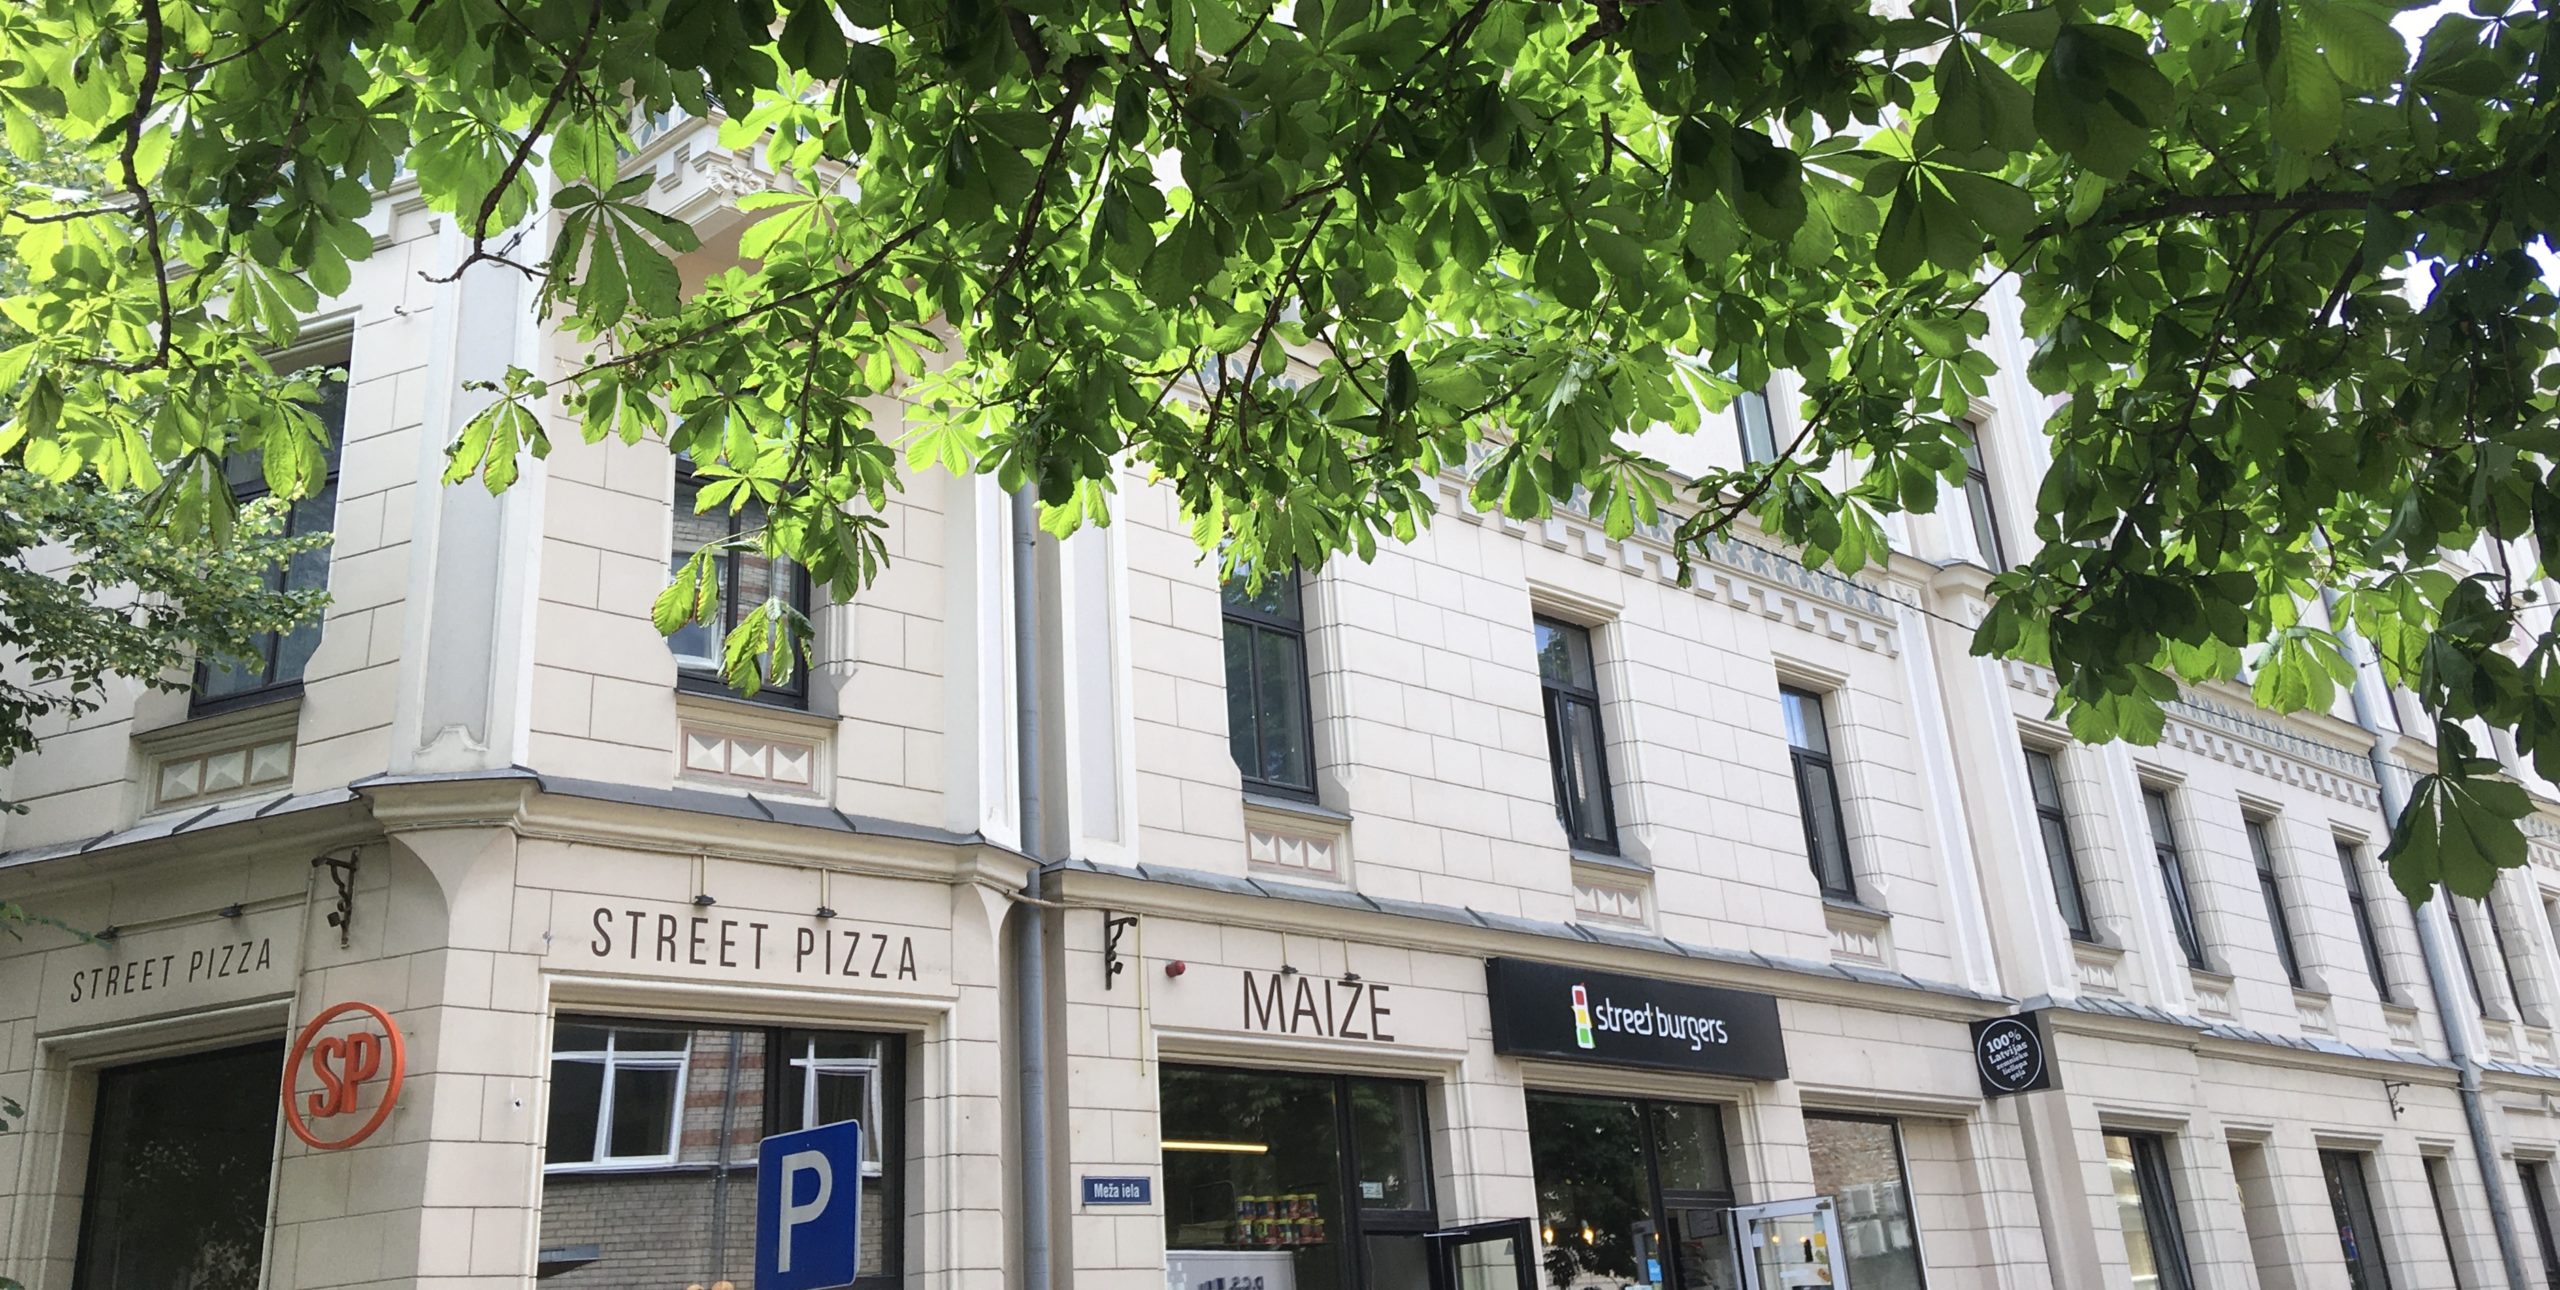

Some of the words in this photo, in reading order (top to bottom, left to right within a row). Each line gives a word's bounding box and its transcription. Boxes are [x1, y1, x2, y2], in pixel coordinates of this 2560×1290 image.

[70, 954, 175, 1003] STREET
[188, 937, 271, 984] PIZZA
[590, 907, 769, 970] STREET
[796, 926, 918, 981] PIZZA
[1243, 970, 1395, 1042] MAIZE
[1595, 997, 1653, 1036] street
[1655, 1005, 1729, 1051] burgers
[1986, 1028, 2022, 1053] 100%
[1988, 1041, 2028, 1065] Latvijas
[308, 1031, 382, 1118] SP
[777, 1149, 833, 1273] P
[1093, 1183, 1119, 1198] Meža
[1121, 1183, 1140, 1198] iela
